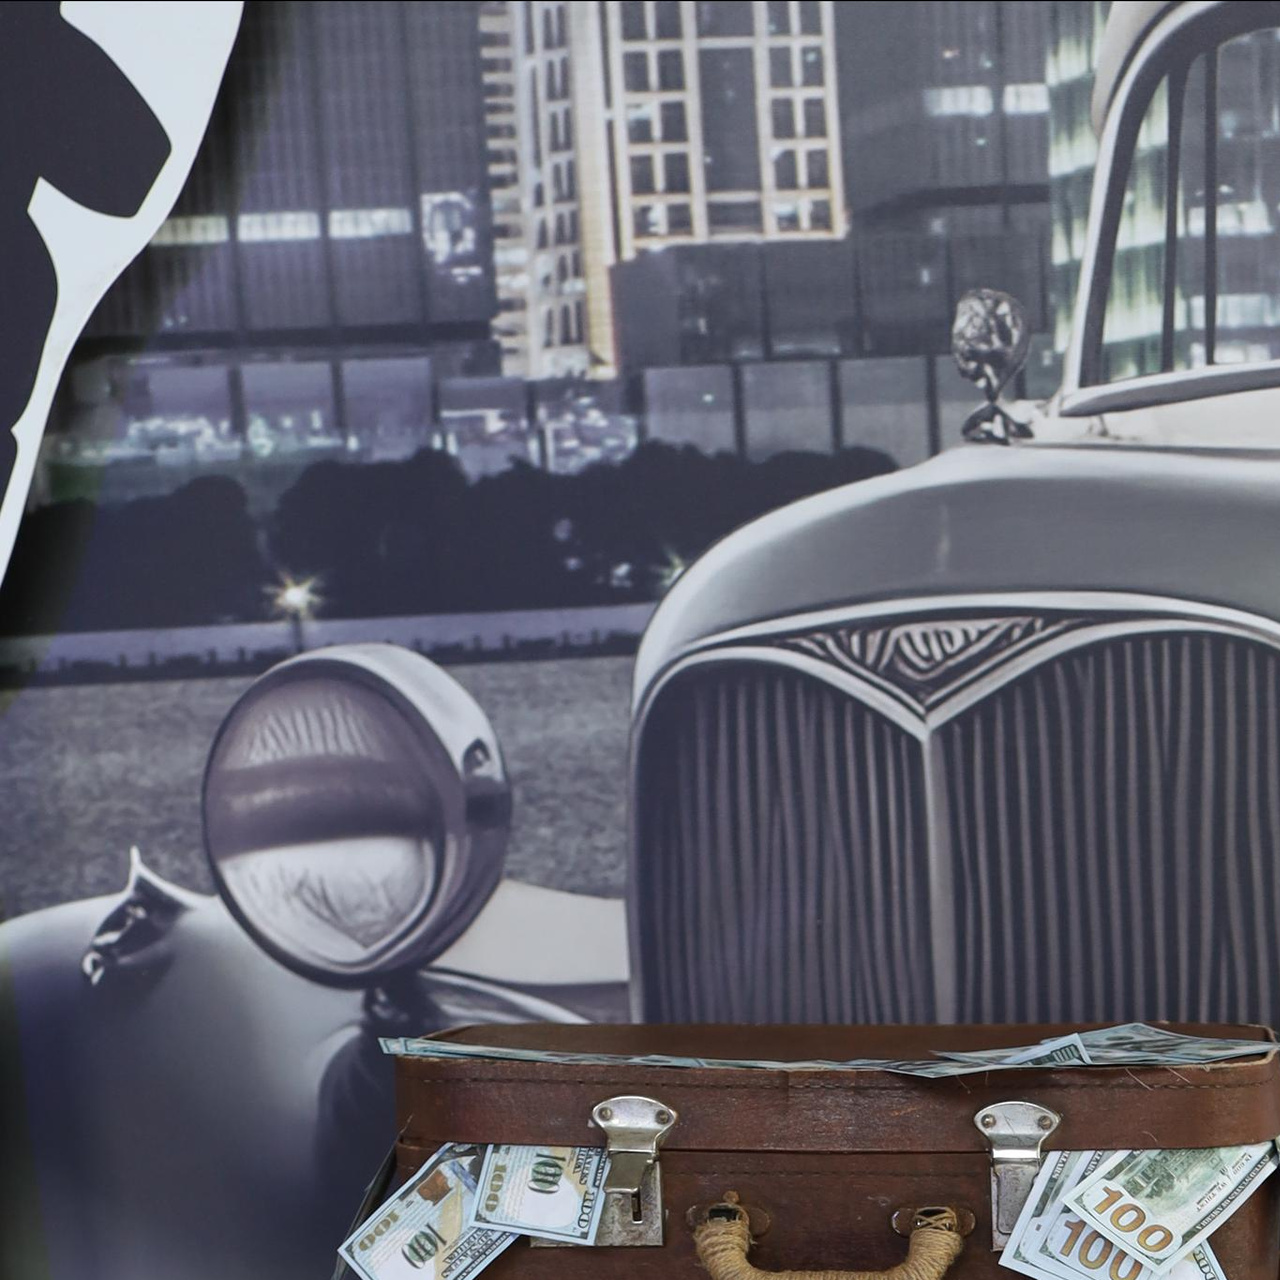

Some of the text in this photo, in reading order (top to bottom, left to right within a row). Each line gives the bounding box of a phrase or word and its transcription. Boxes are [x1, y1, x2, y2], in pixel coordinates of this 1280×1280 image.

[483, 1164, 506, 1213] 100
[526, 1153, 565, 1196] 100
[355, 1207, 400, 1253] 100
[577, 1190, 594, 1229] 100
[1093, 1186, 1174, 1251] 100
[397, 1220, 447, 1273] 100
